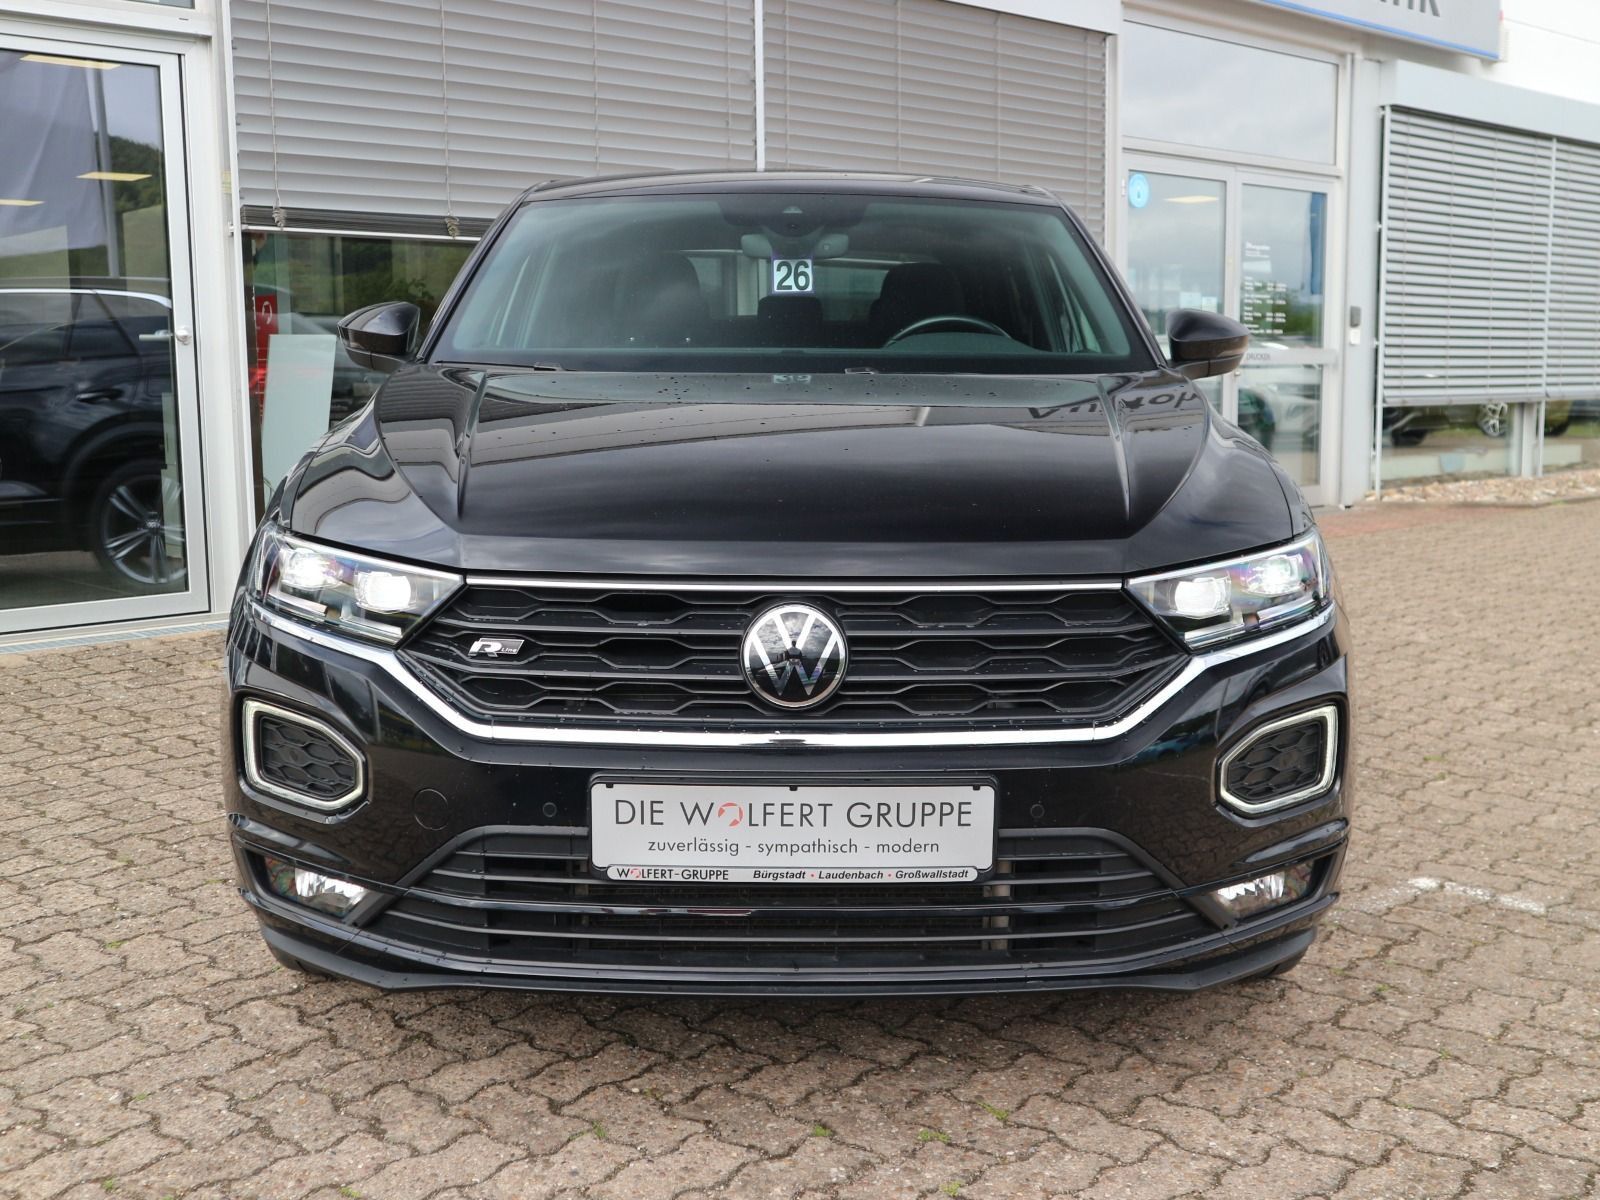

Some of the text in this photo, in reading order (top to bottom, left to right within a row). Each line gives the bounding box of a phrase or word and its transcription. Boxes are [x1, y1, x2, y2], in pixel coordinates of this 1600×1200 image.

[775, 260, 811, 291] 26
[615, 799, 972, 828] DIE WOLFERT GRUPPE
[648, 836, 739, 857] zuverlässig
[758, 838, 858, 857] sympathisch
[876, 837, 939, 854] modern
[752, 869, 969, 880] Bürgstadt Laudenbach Großwallstadt
